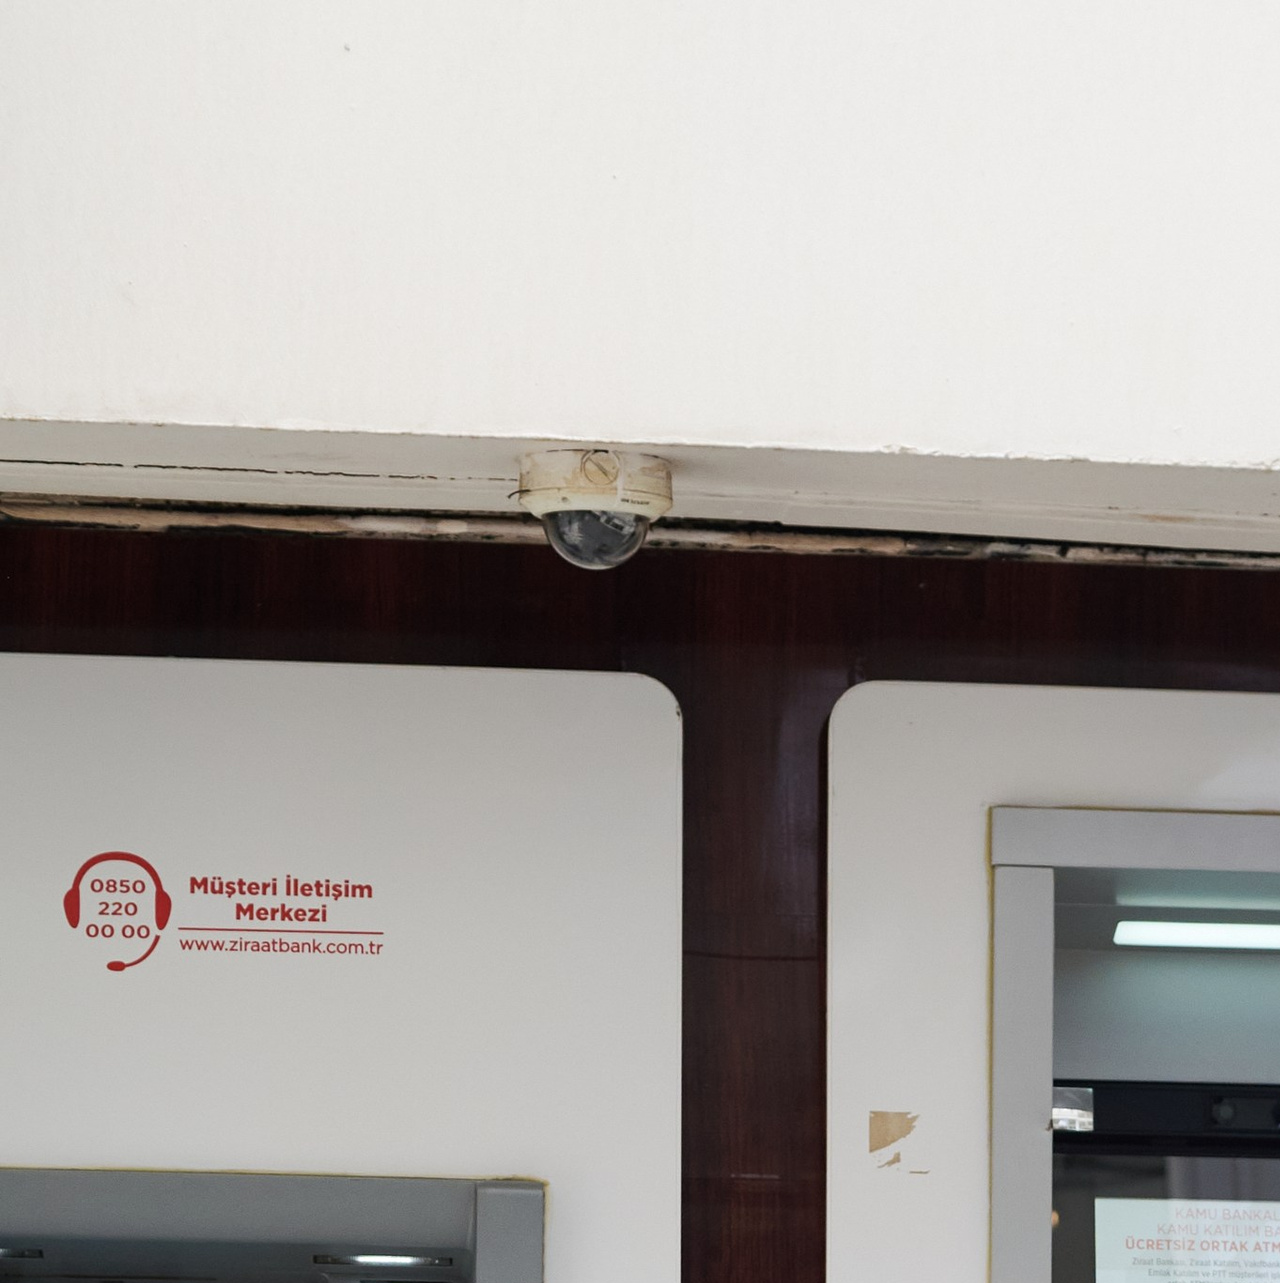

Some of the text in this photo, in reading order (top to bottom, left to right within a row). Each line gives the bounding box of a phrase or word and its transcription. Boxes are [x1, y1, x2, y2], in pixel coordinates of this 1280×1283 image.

[90, 878, 146, 894] 0850
[189, 874, 374, 901] Müşteri İletişim
[98, 901, 138, 916] 220
[235, 902, 328, 922] Merkezi
[86, 923, 151, 939] 00 00
[179, 937, 384, 955] www.ziraatbank.com.tr
[1174, 1207, 1218, 1220] KAMU
[1156, 1223, 1199, 1235] KAMU
[1203, 1224, 1260, 1237] KATILIM
[1125, 1235, 1196, 1251] ÜCRETSİZ
[1199, 1239, 1248, 1252] ORTAK
